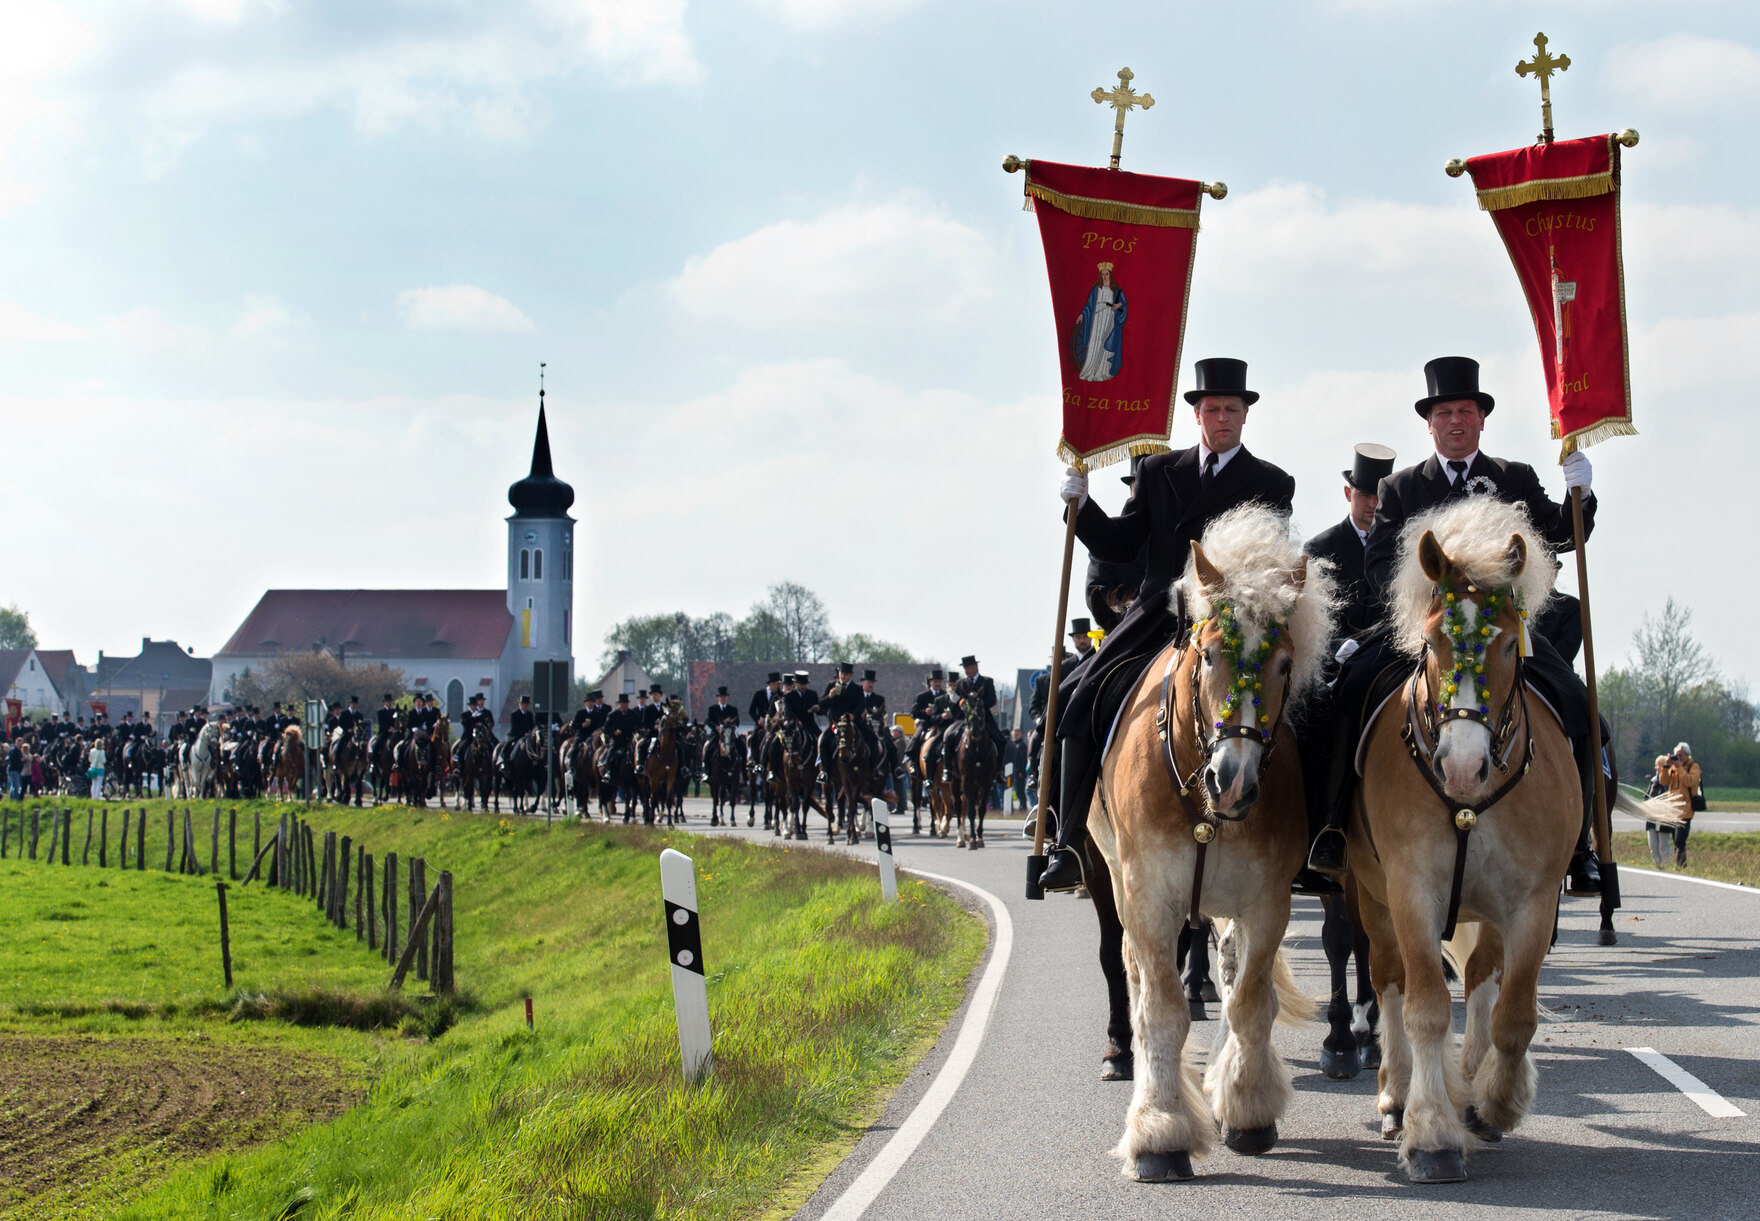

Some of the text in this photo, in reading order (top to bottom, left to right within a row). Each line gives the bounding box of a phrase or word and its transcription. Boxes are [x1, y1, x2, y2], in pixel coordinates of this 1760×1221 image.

[1081, 231, 1140, 254] Proš
[1087, 397, 1110, 410] za
[1116, 398, 1150, 411] nas
